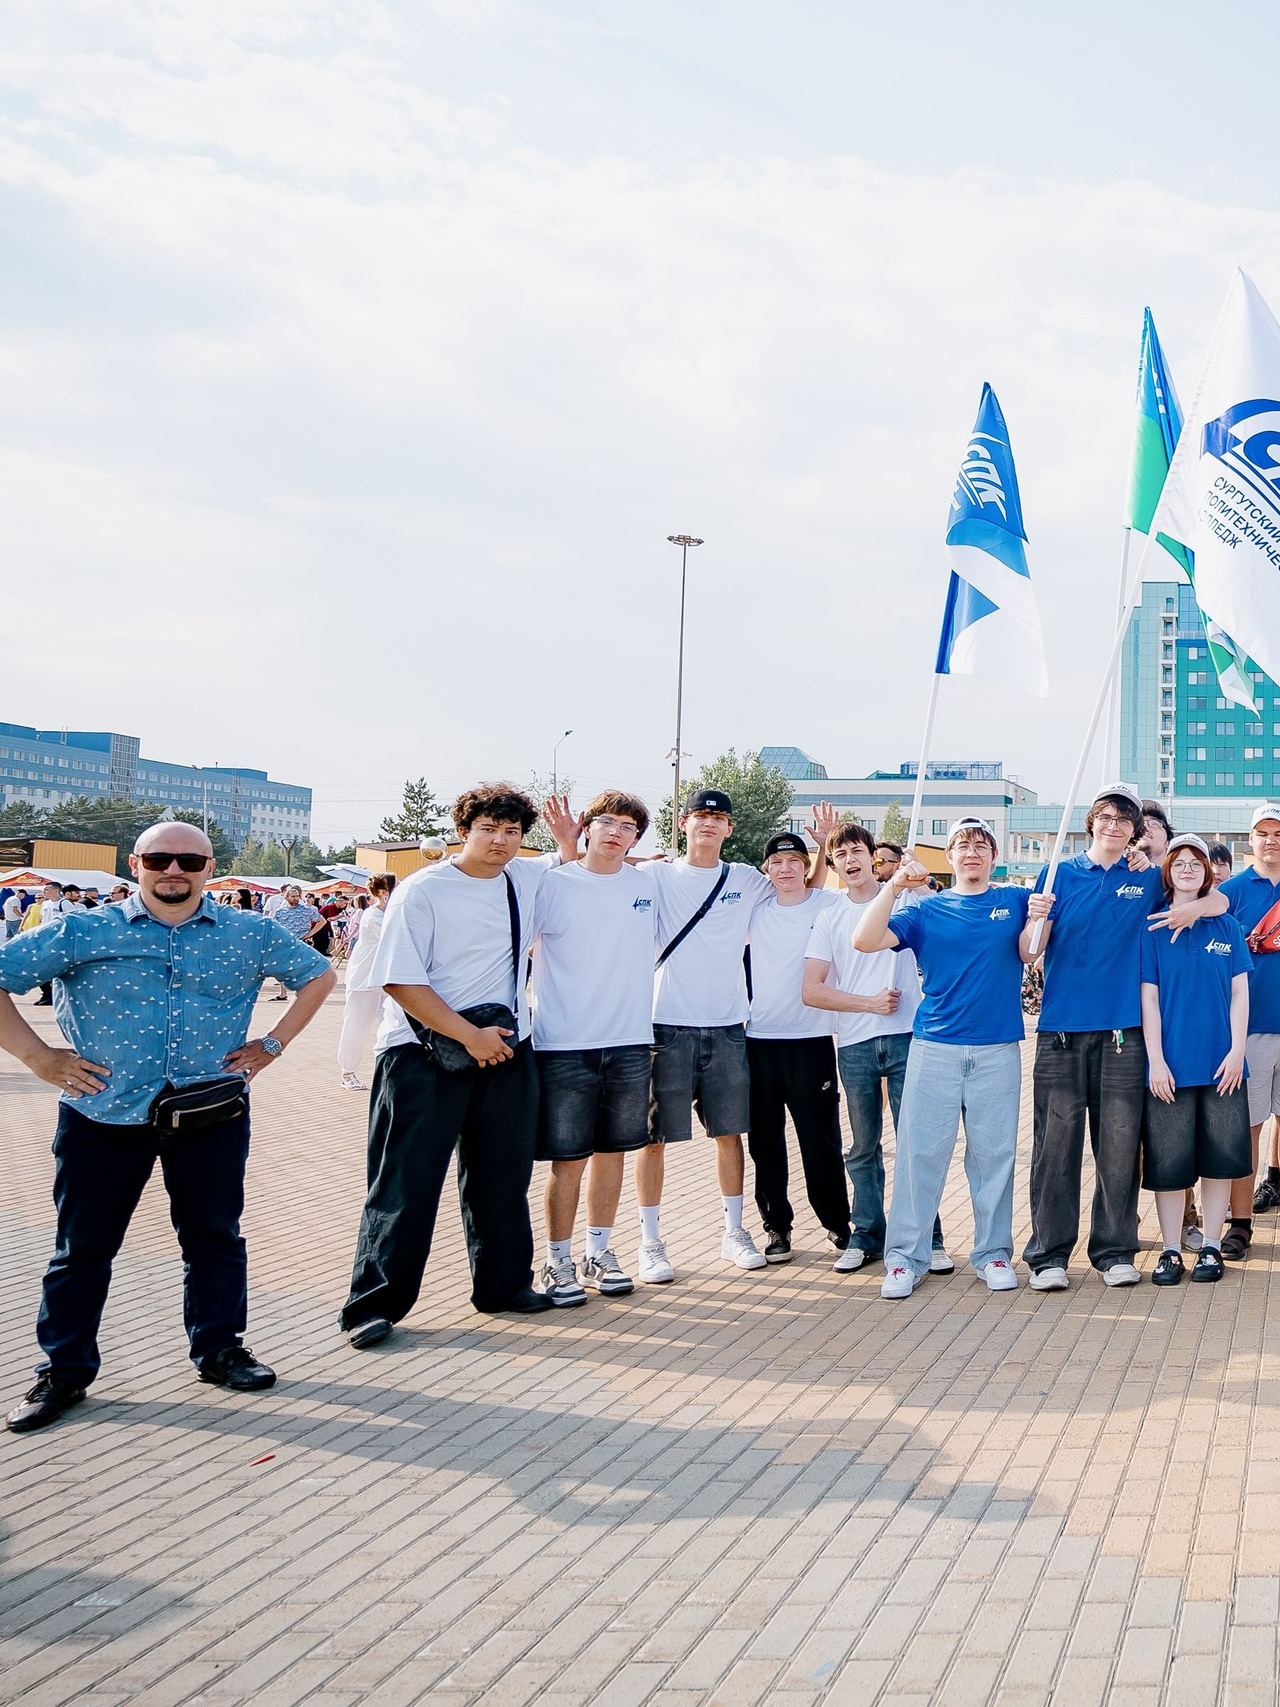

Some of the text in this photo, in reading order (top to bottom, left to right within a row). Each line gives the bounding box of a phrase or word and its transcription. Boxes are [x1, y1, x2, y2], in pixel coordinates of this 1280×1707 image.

[961, 444, 1008, 522] СПК
[1197, 507, 1243, 549] ОЛЛЕДЖ
[1125, 885, 1145, 895] СПК
[1214, 941, 1232, 951] СПК
